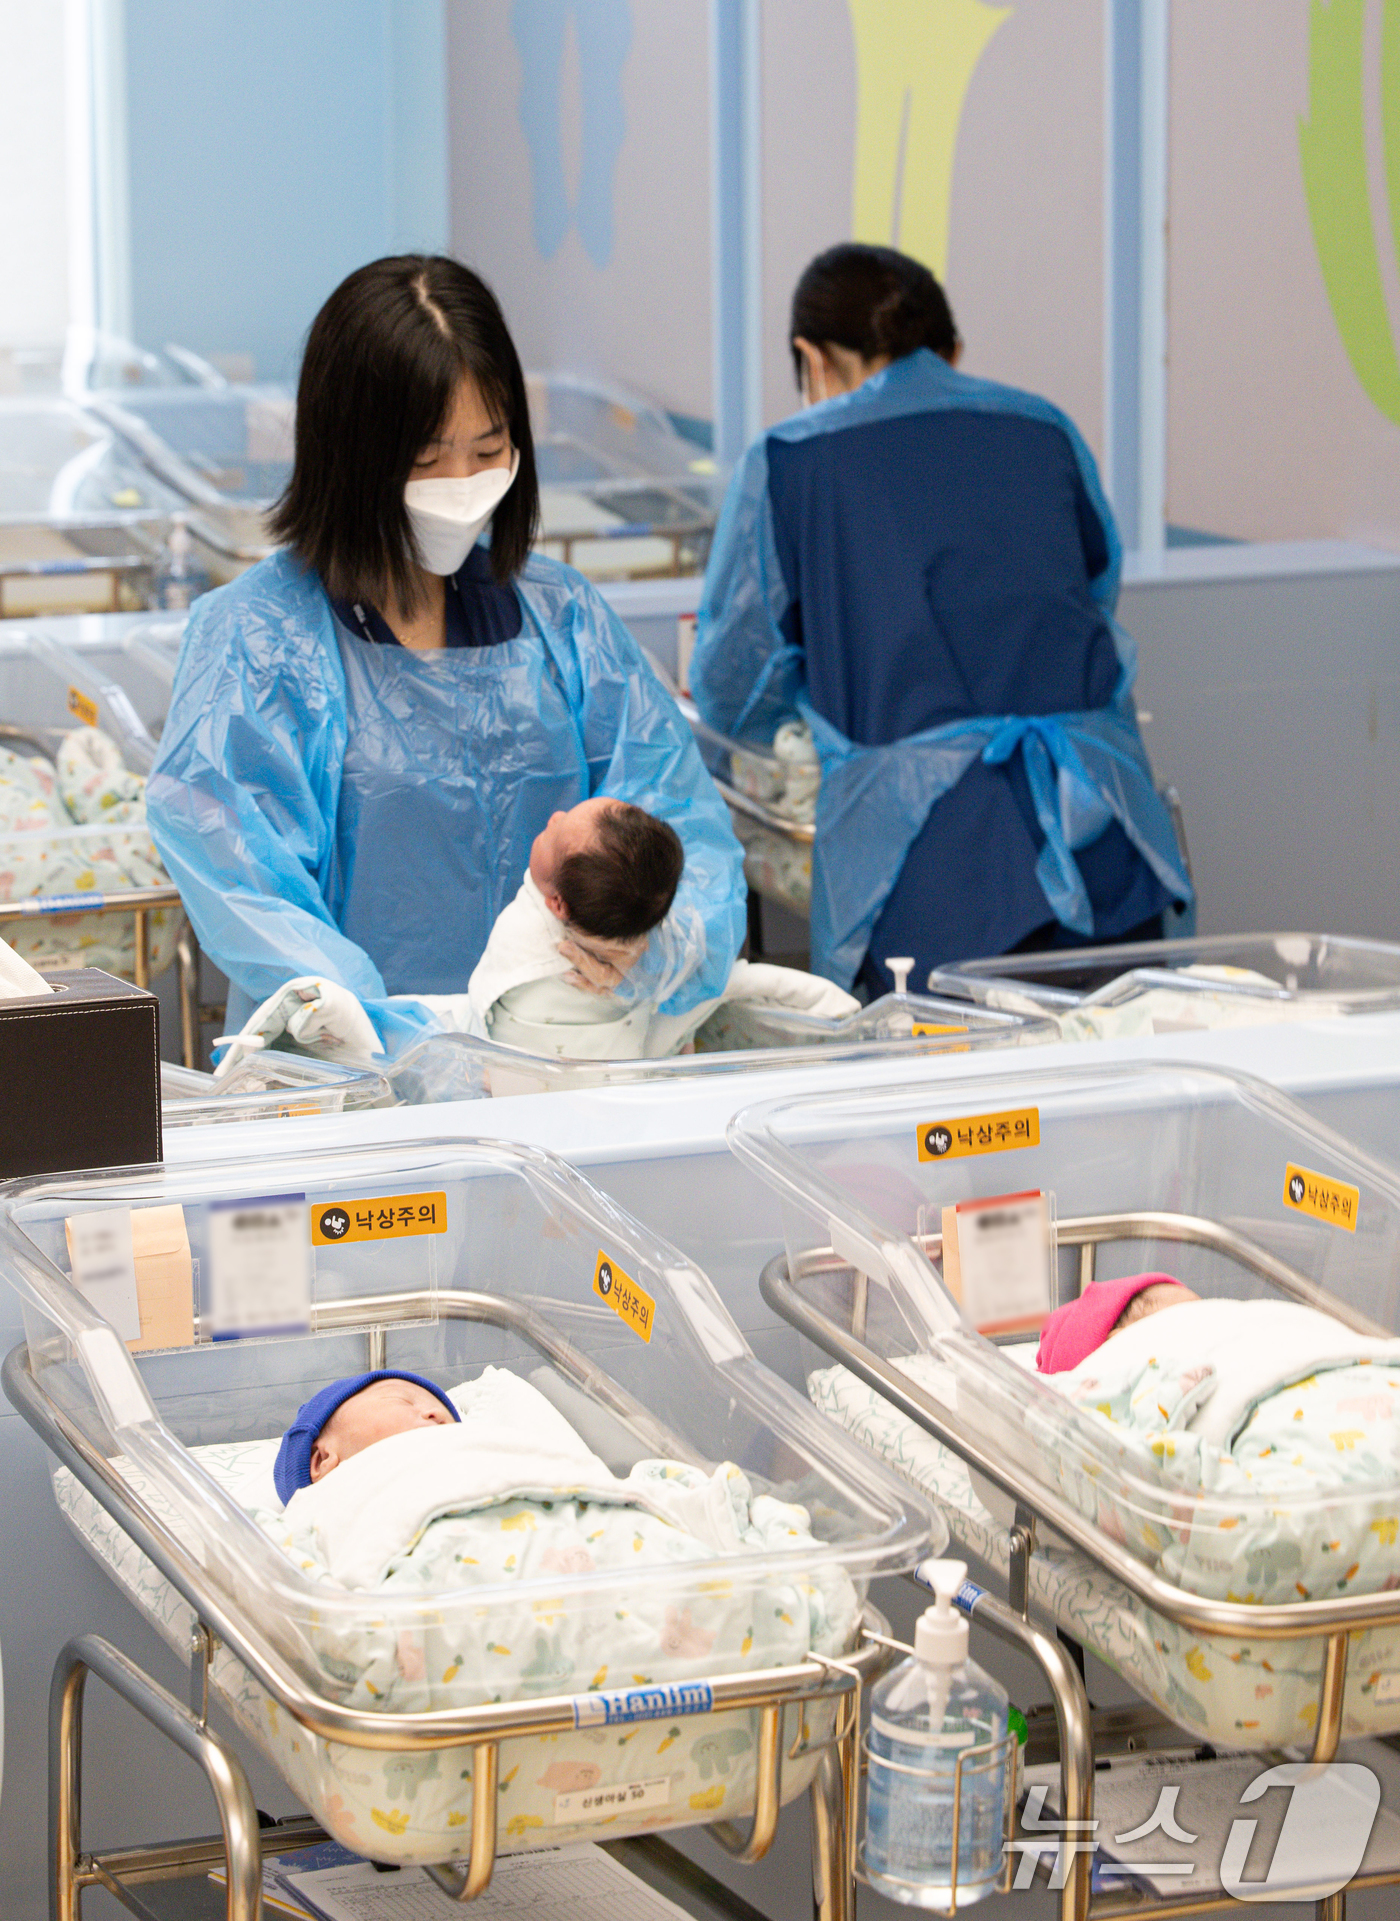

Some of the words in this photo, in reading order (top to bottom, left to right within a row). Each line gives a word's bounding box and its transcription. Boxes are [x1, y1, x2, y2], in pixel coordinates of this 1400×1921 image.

[957, 1117, 1030, 1147] 낙상주의
[1308, 1184, 1352, 1220] 낙상주의
[355, 1204, 436, 1231] 낙상주의
[614, 1279, 649, 1330] 낙상주의
[608, 1686, 709, 1715] Hanlim
